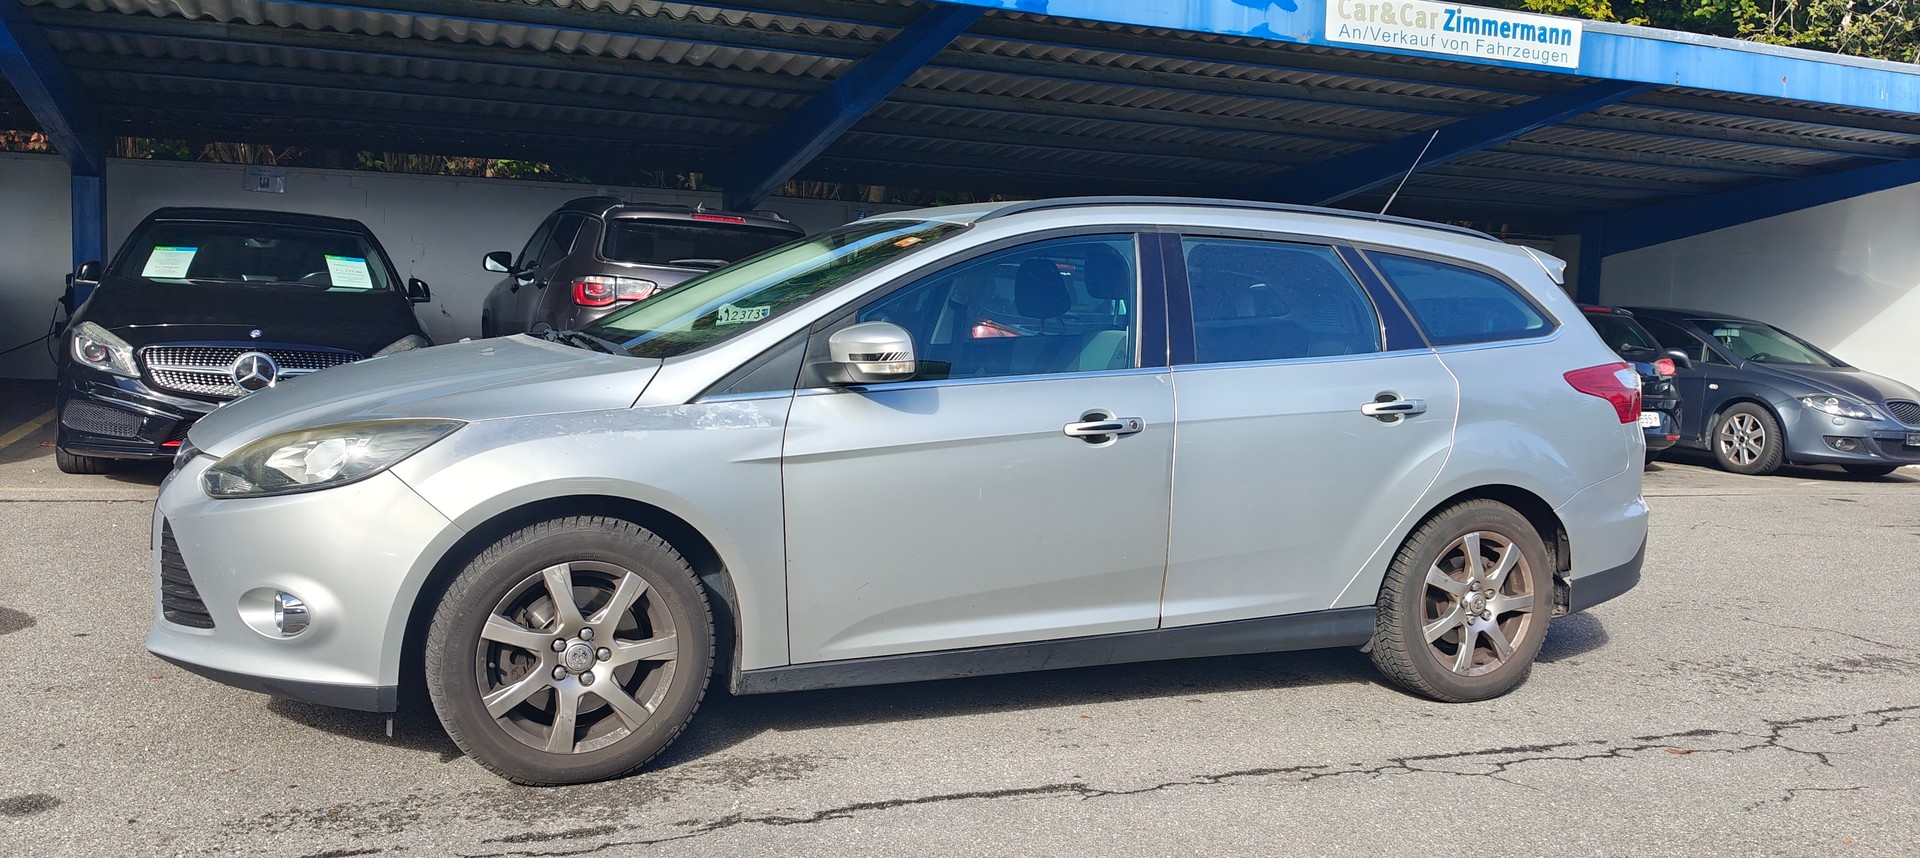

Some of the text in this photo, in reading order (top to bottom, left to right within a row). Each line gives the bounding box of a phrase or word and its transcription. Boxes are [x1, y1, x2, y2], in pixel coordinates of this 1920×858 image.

[1337, 0, 1572, 46] Car&Car Zimmermann
[1338, 24, 1568, 64] An/Verkauf von Fahrzeugen
